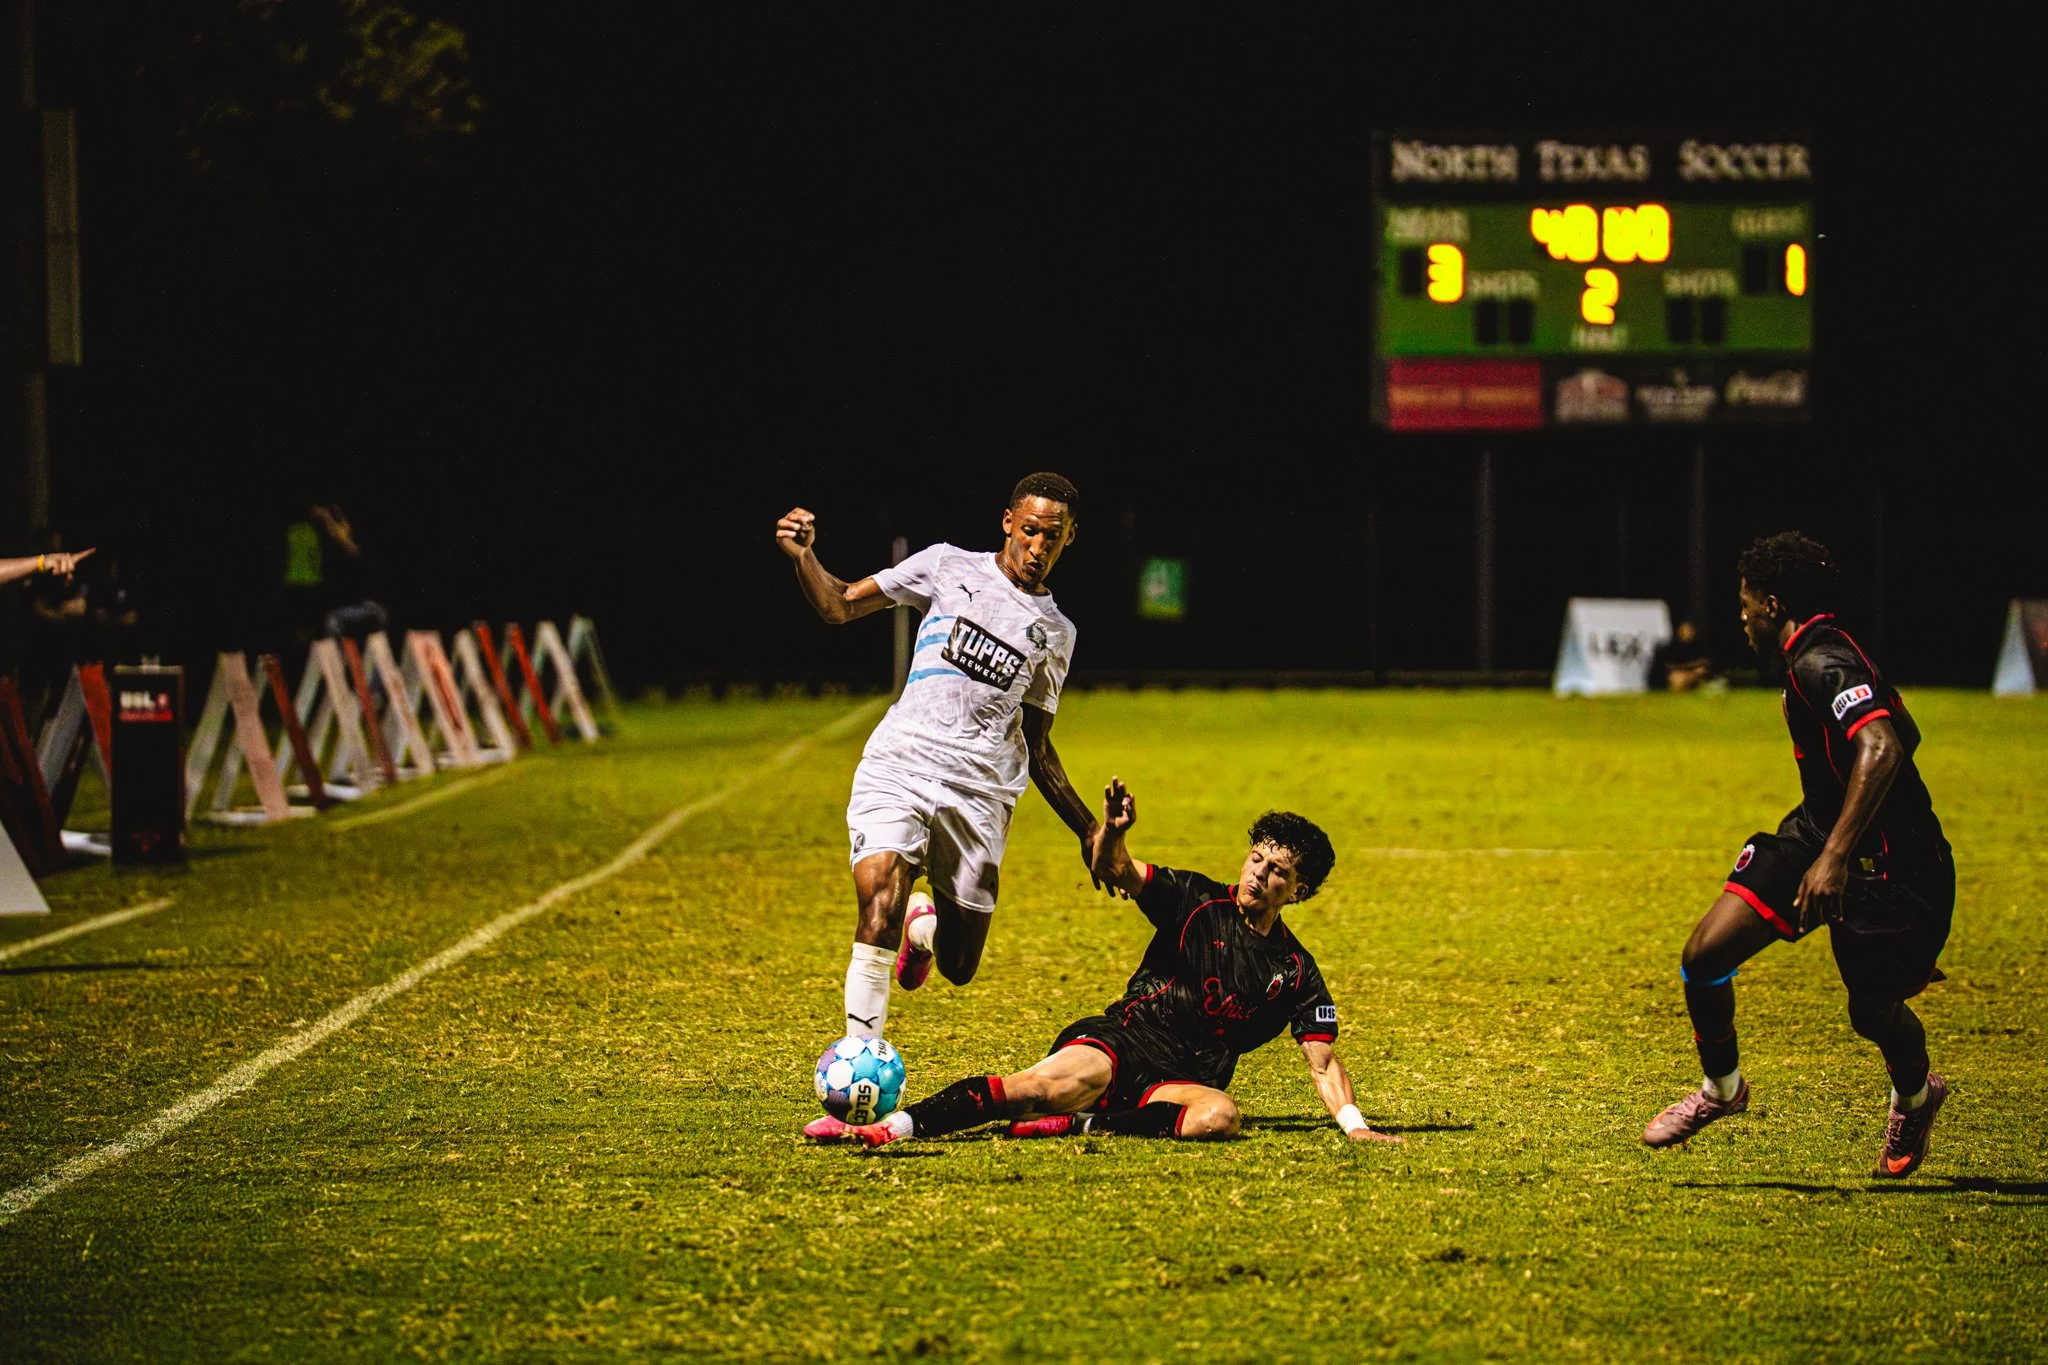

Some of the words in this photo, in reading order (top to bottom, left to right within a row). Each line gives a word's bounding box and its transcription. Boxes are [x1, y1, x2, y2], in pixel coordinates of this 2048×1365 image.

[1392, 140, 1518, 181] NORTH
[1536, 140, 1649, 181] TEXAS
[1679, 140, 1811, 181] SOCCER
[1427, 243, 1464, 303] 3
[1581, 267, 1619, 325] 2
[1785, 243, 1807, 296] 1
[951, 622, 1020, 678] TUPPS
[952, 652, 1003, 684] BREWERY
[1318, 1006, 1336, 1020] US
